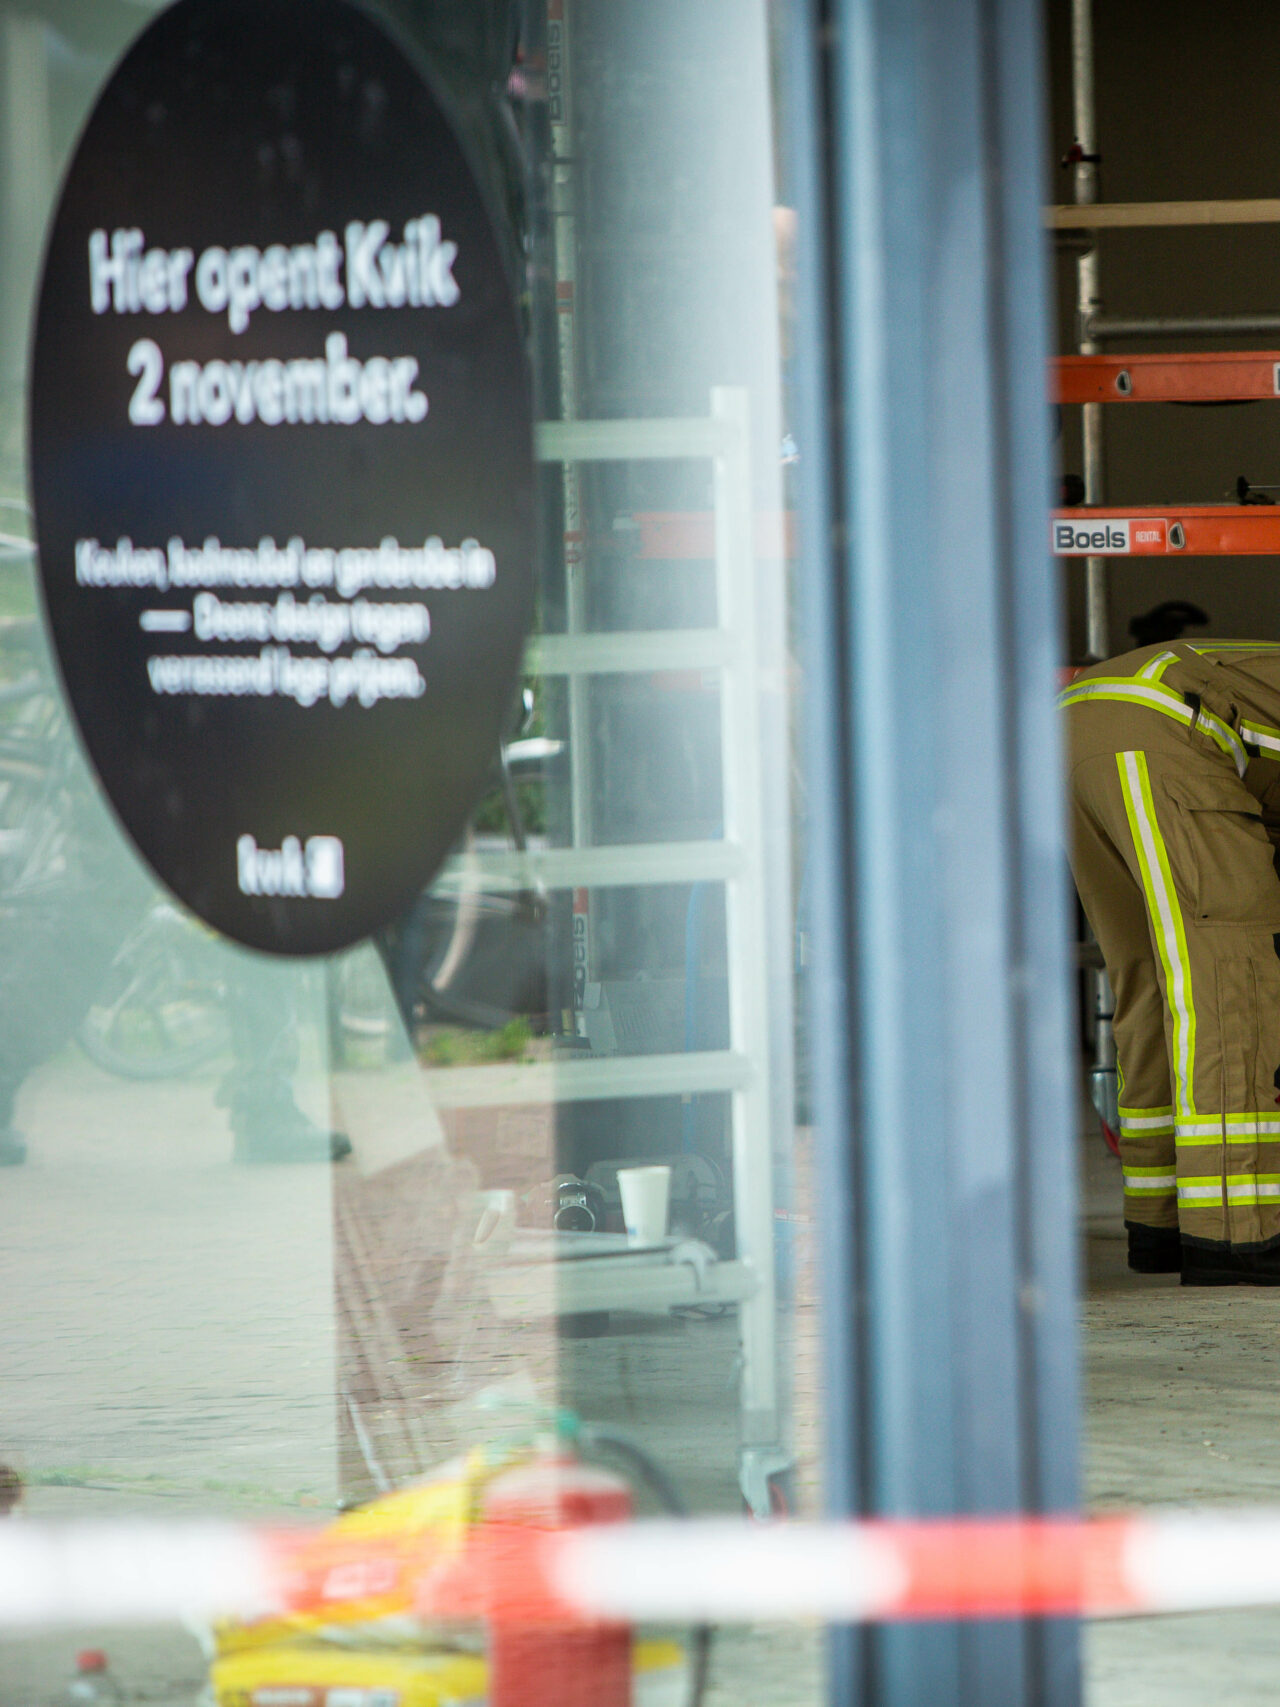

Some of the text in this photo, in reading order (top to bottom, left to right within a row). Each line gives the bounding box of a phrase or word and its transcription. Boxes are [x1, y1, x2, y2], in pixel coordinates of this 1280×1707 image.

[89, 213, 461, 335] Hier opent Kvik
[127, 332, 429, 427] 2 november.
[1056, 525, 1162, 549] Boels RENTAL
